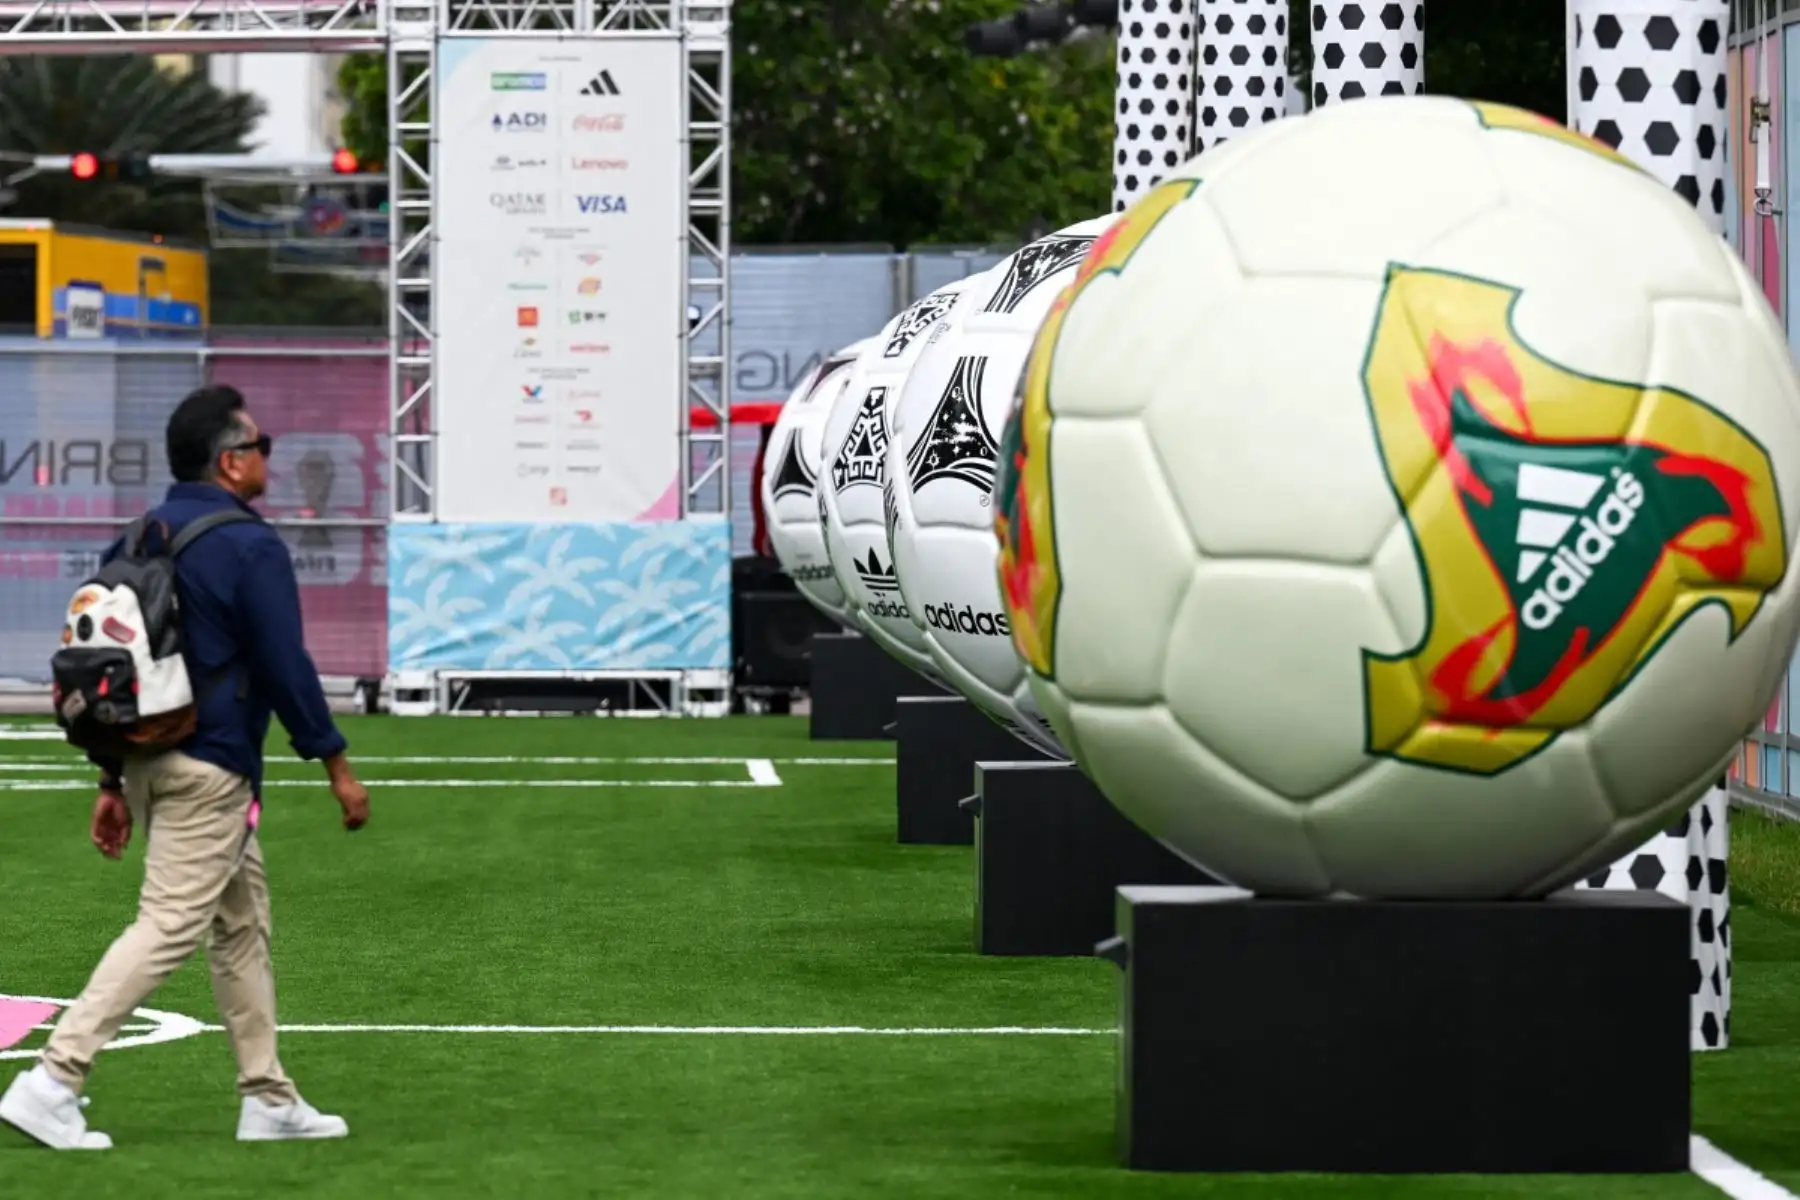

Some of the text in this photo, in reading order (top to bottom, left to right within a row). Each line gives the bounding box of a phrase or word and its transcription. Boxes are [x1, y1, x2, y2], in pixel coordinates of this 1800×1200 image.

[507, 112, 547, 127] ADI
[576, 195, 627, 214] VISA
[1521, 471, 1645, 630] adidas
[925, 602, 1011, 636] adidas
